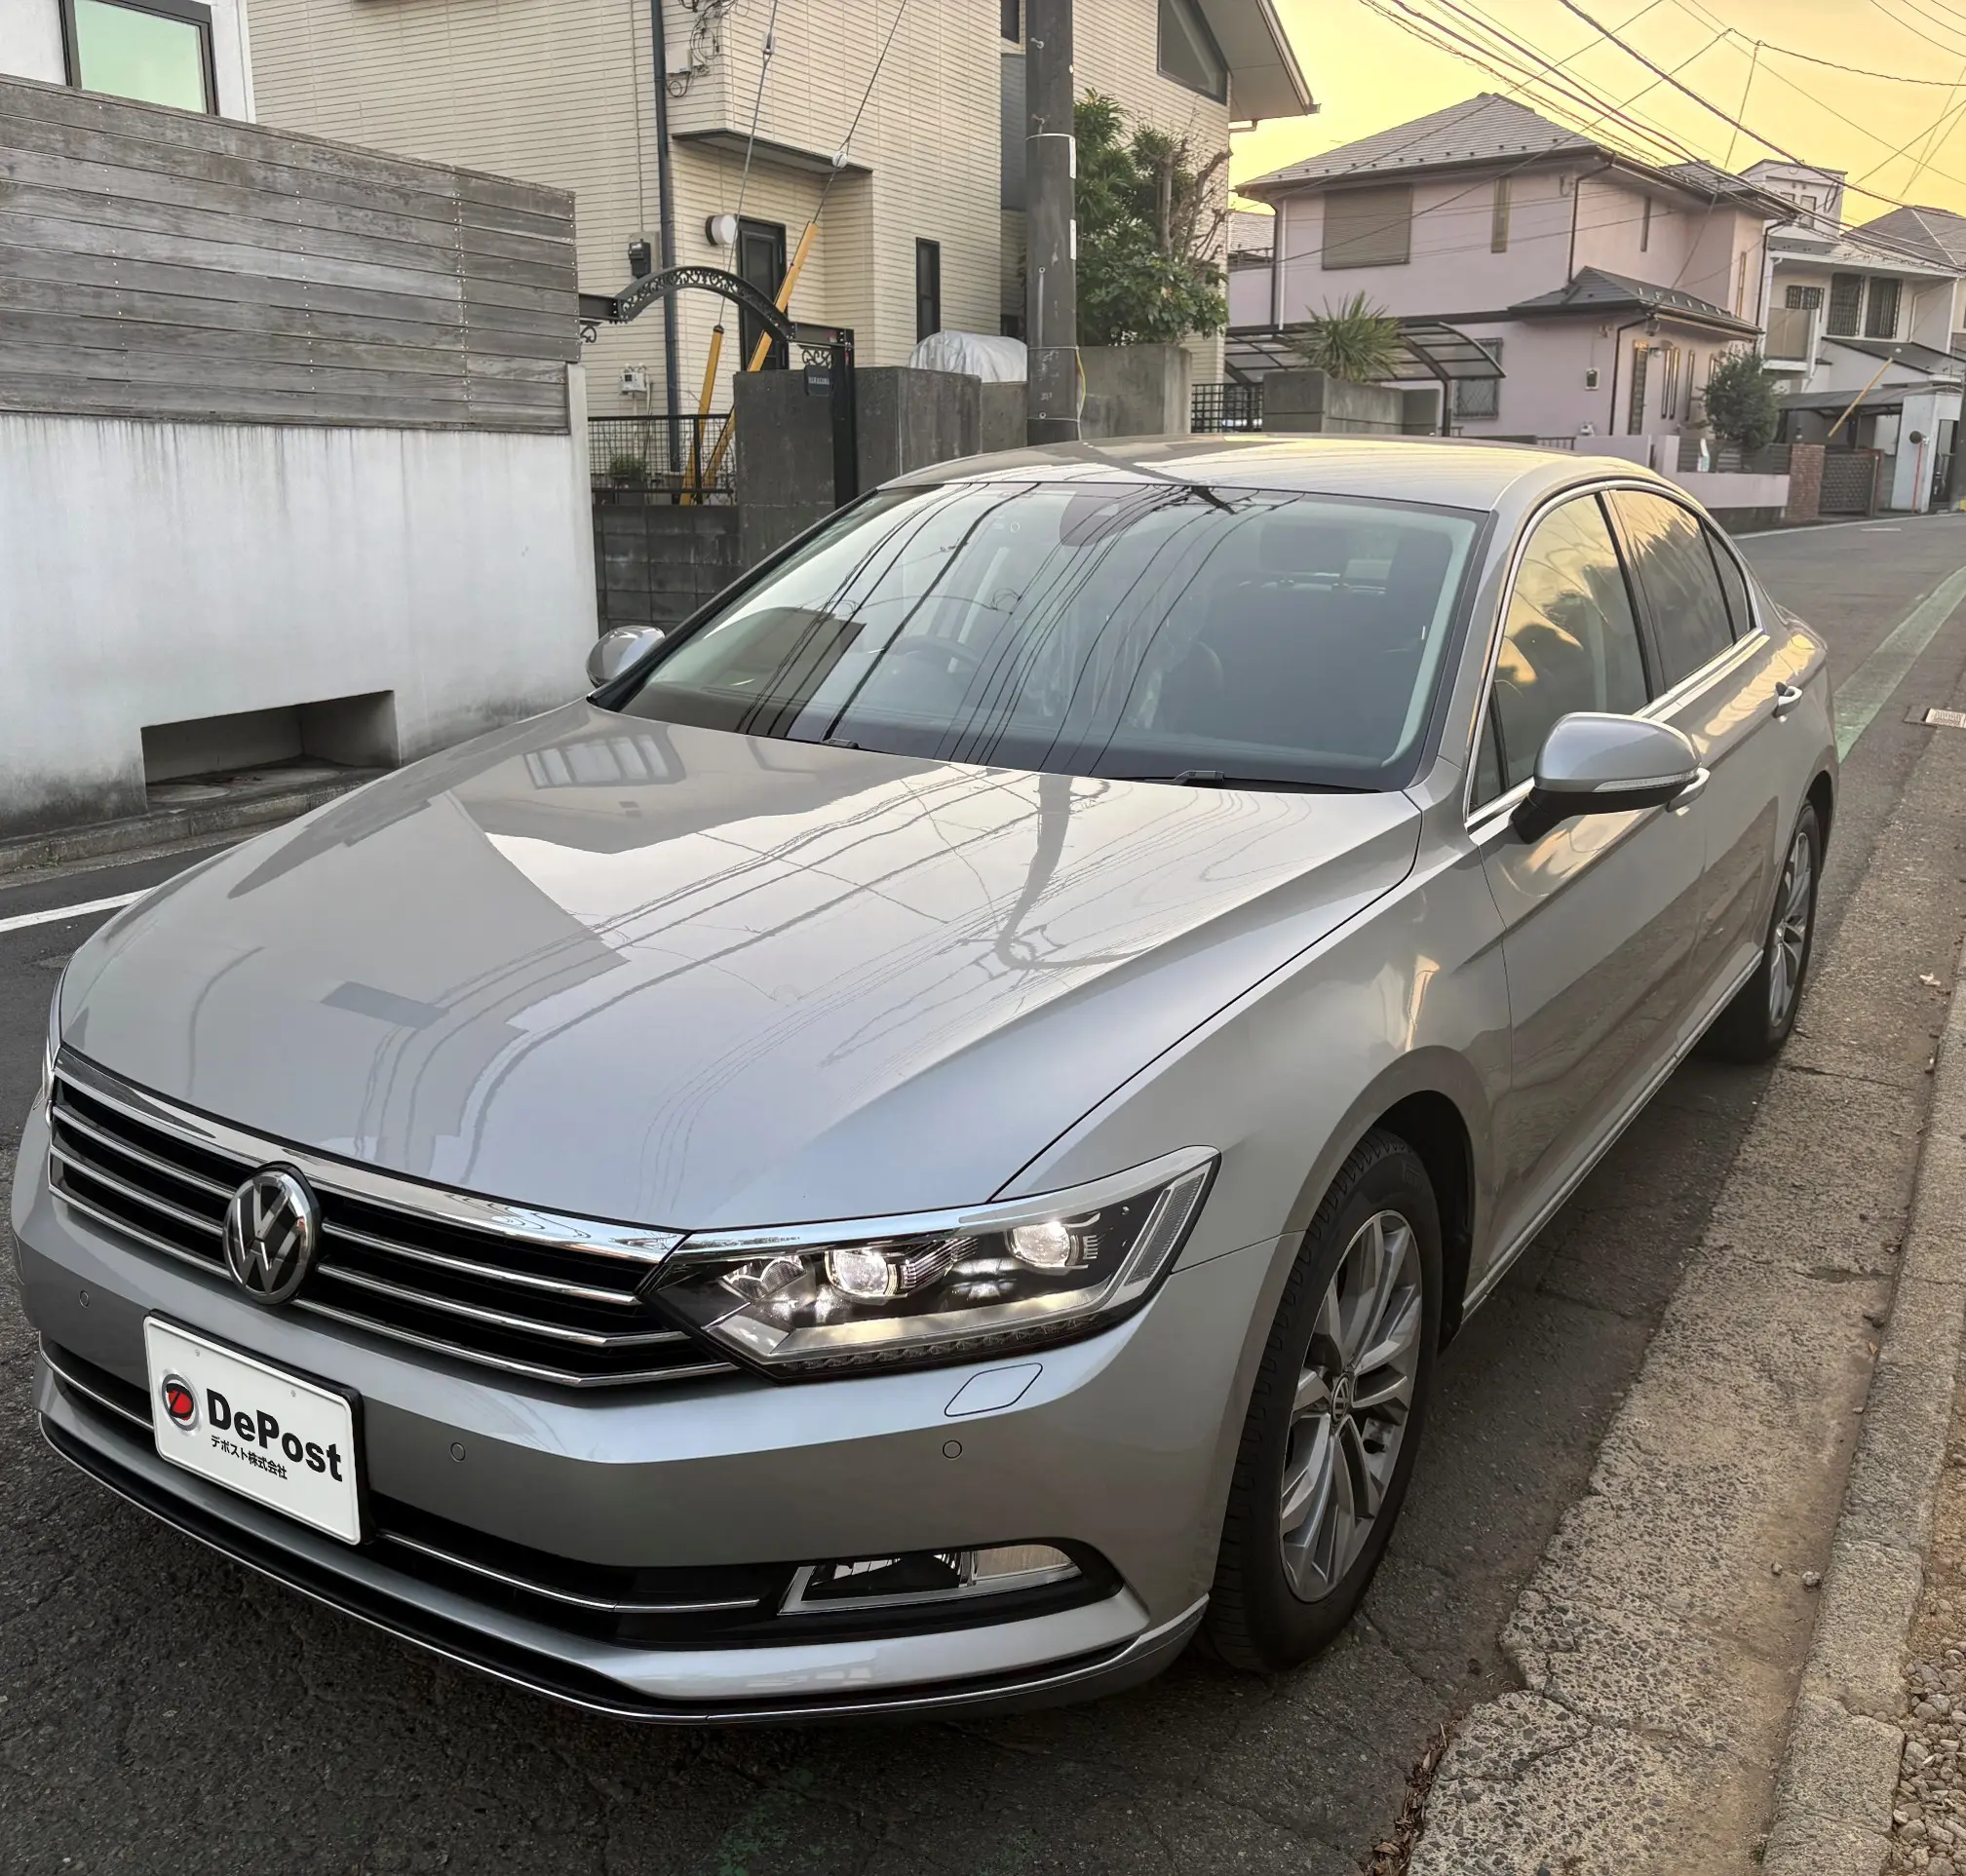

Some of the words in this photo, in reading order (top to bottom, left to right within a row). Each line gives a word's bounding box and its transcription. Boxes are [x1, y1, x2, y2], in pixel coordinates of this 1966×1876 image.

[206, 1388, 343, 1482] DePost
[211, 1435, 289, 1480] デポスト株式会社
